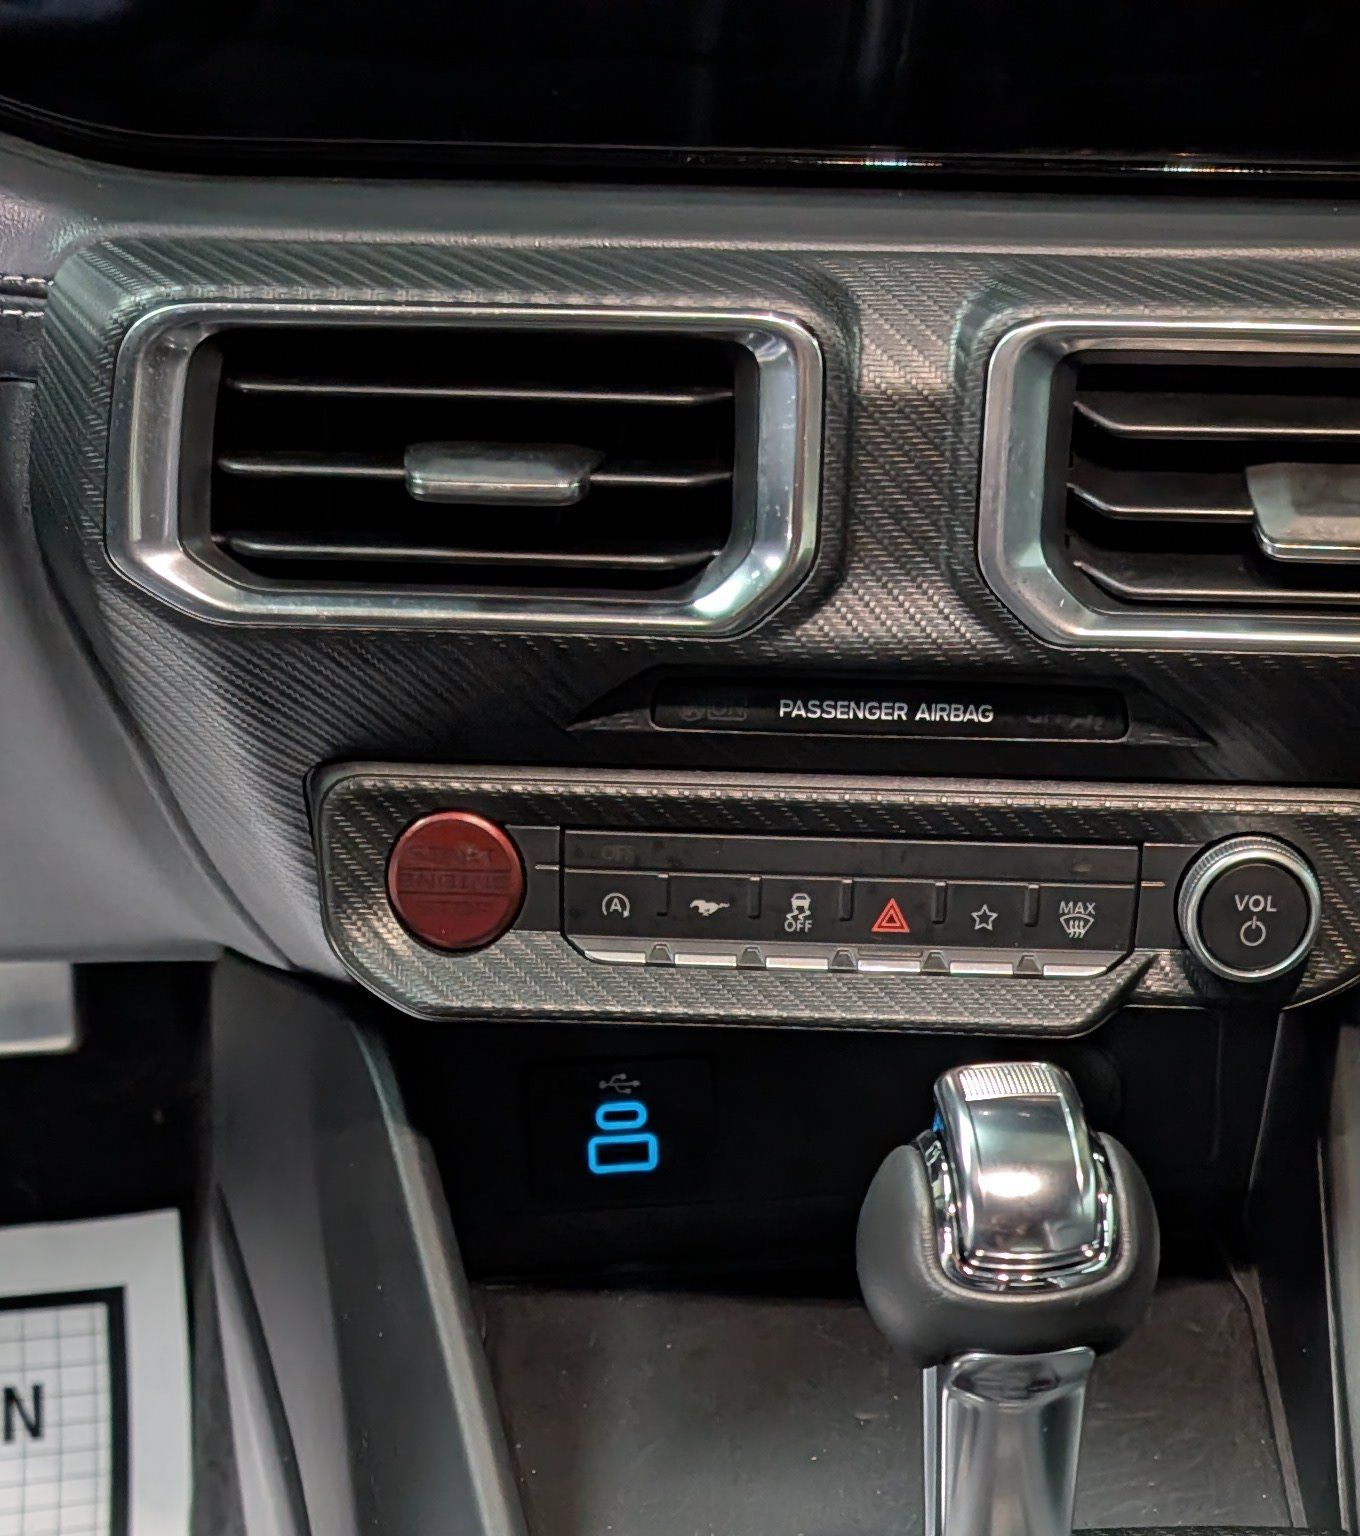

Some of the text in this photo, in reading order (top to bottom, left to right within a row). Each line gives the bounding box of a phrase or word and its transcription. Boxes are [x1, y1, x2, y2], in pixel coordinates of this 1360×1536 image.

[779, 700, 994, 723] PASSENGER AIRBAG
[1059, 901, 1096, 915] MAX
[1235, 895, 1277, 913] VOL
[784, 920, 813, 933] OFF
